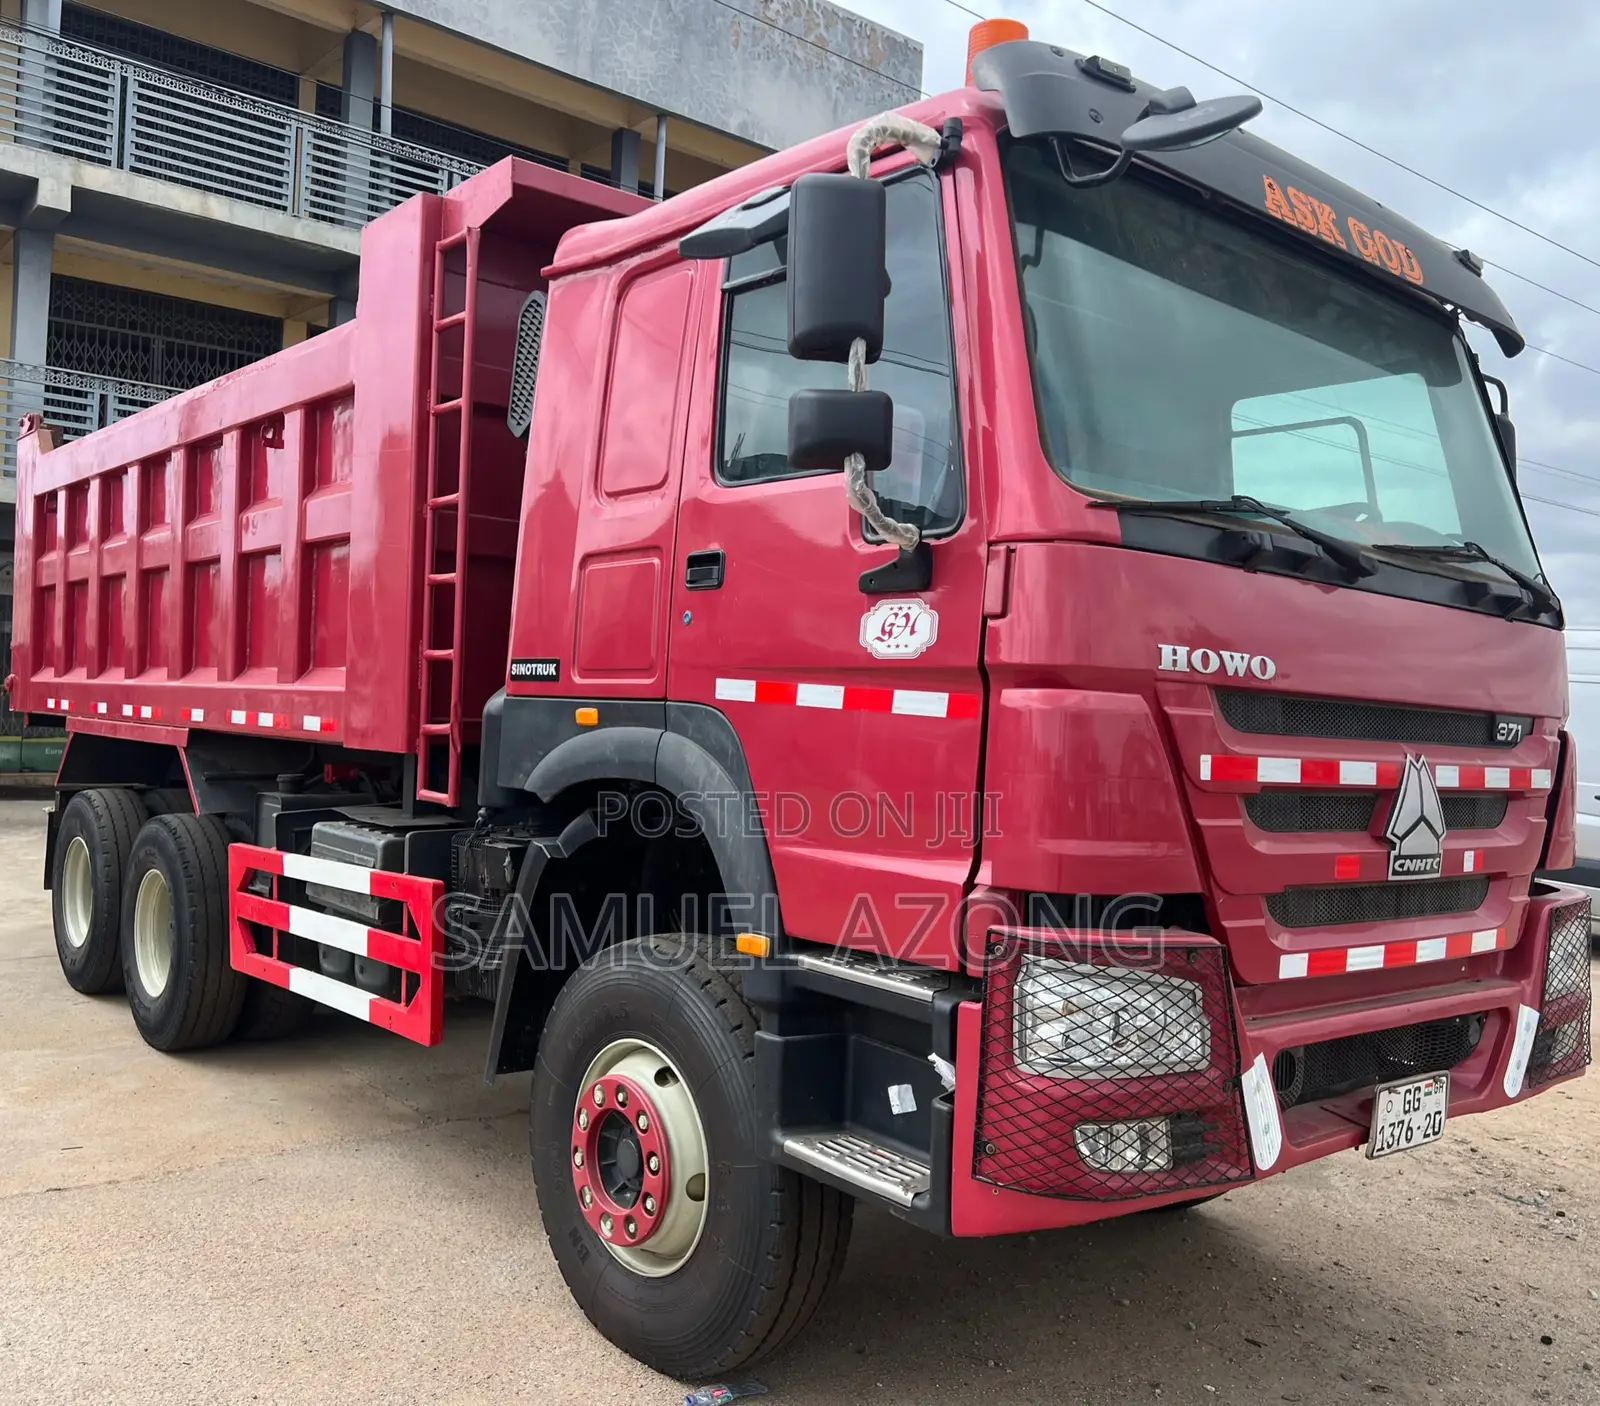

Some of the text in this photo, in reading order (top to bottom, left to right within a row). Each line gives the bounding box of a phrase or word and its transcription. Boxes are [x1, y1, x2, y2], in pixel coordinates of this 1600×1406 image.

[1263, 175, 1424, 285] ASK GOD
[511, 663, 557, 676] SINOTRUK
[1158, 644, 1277, 680] HOWO
[1496, 722, 1522, 742] 371
[1394, 857, 1441, 872] CNHTC
[1403, 1086, 1422, 1115] GG
[1376, 1110, 1442, 1152] 1376-20
